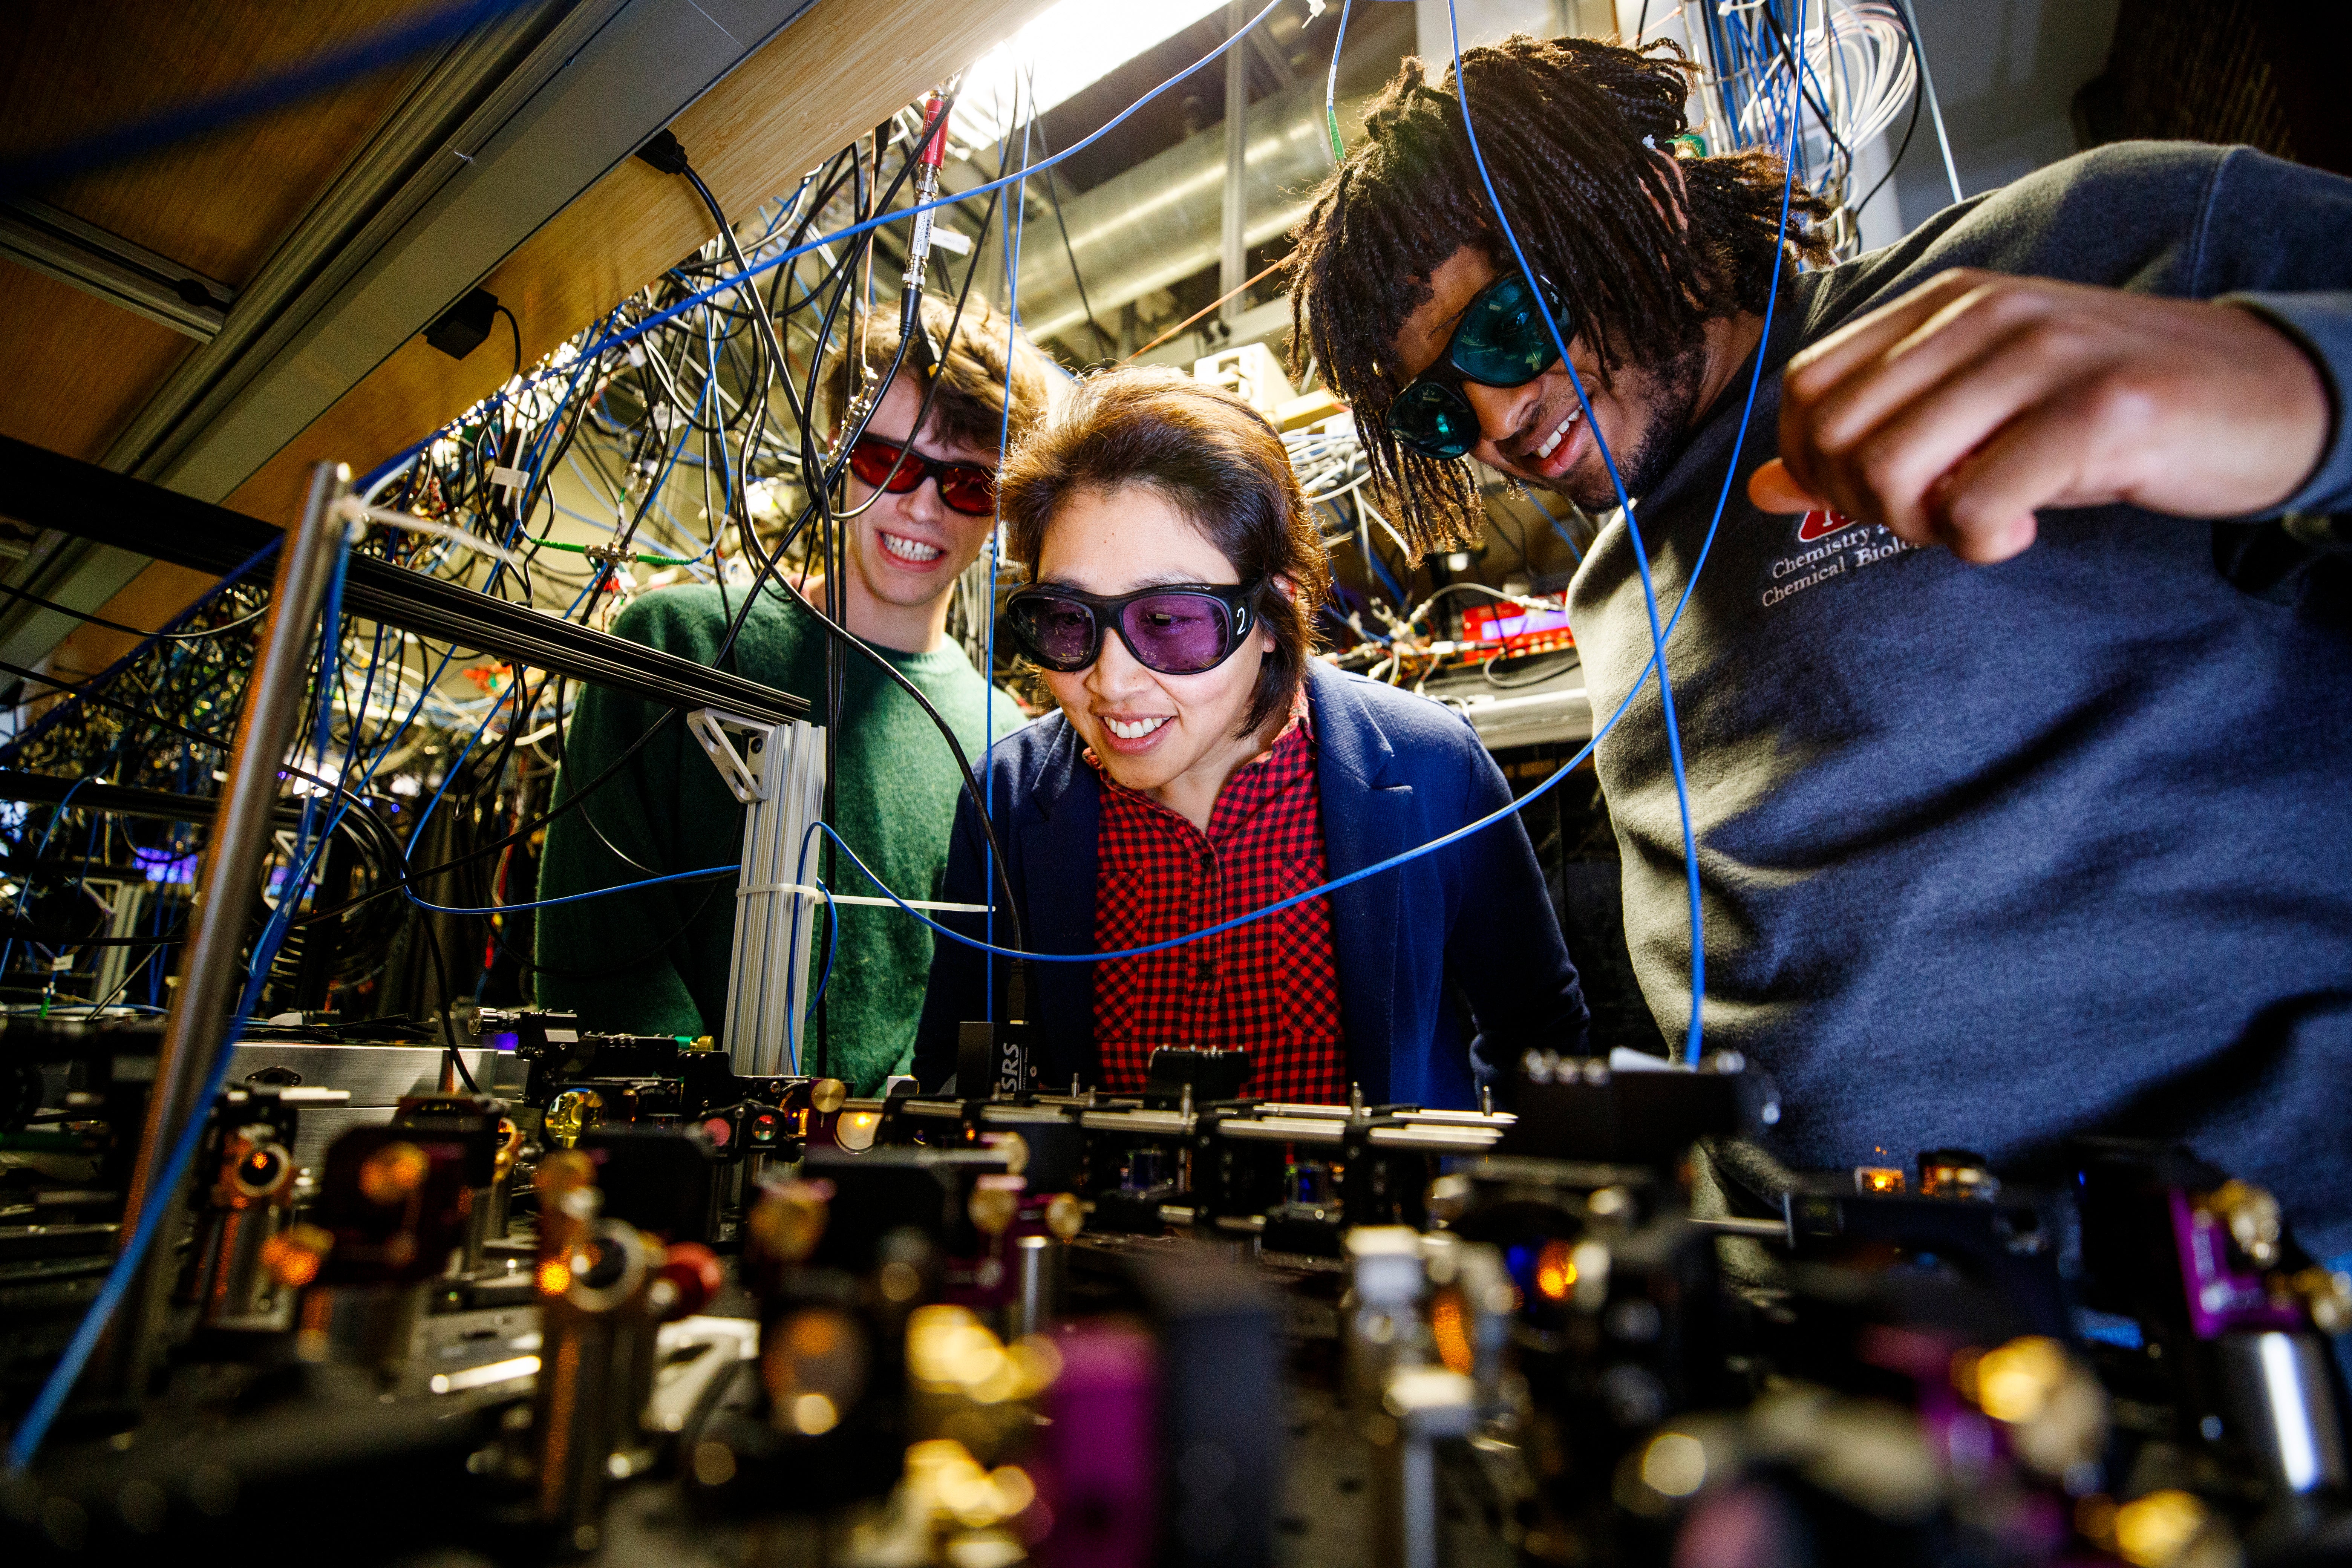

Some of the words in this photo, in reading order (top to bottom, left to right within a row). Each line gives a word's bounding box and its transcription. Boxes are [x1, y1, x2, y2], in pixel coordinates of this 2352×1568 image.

[917, 210, 926, 243] Mini-Circuit
[1762, 556, 1845, 607] Chemical
[1856, 536, 1919, 567] Biol
[1772, 527, 1870, 579] Chemistry
[1237, 607, 1246, 635] 2
[913, 692, 928, 708] 1394-2000
[1001, 1043, 1019, 1092] SRS
